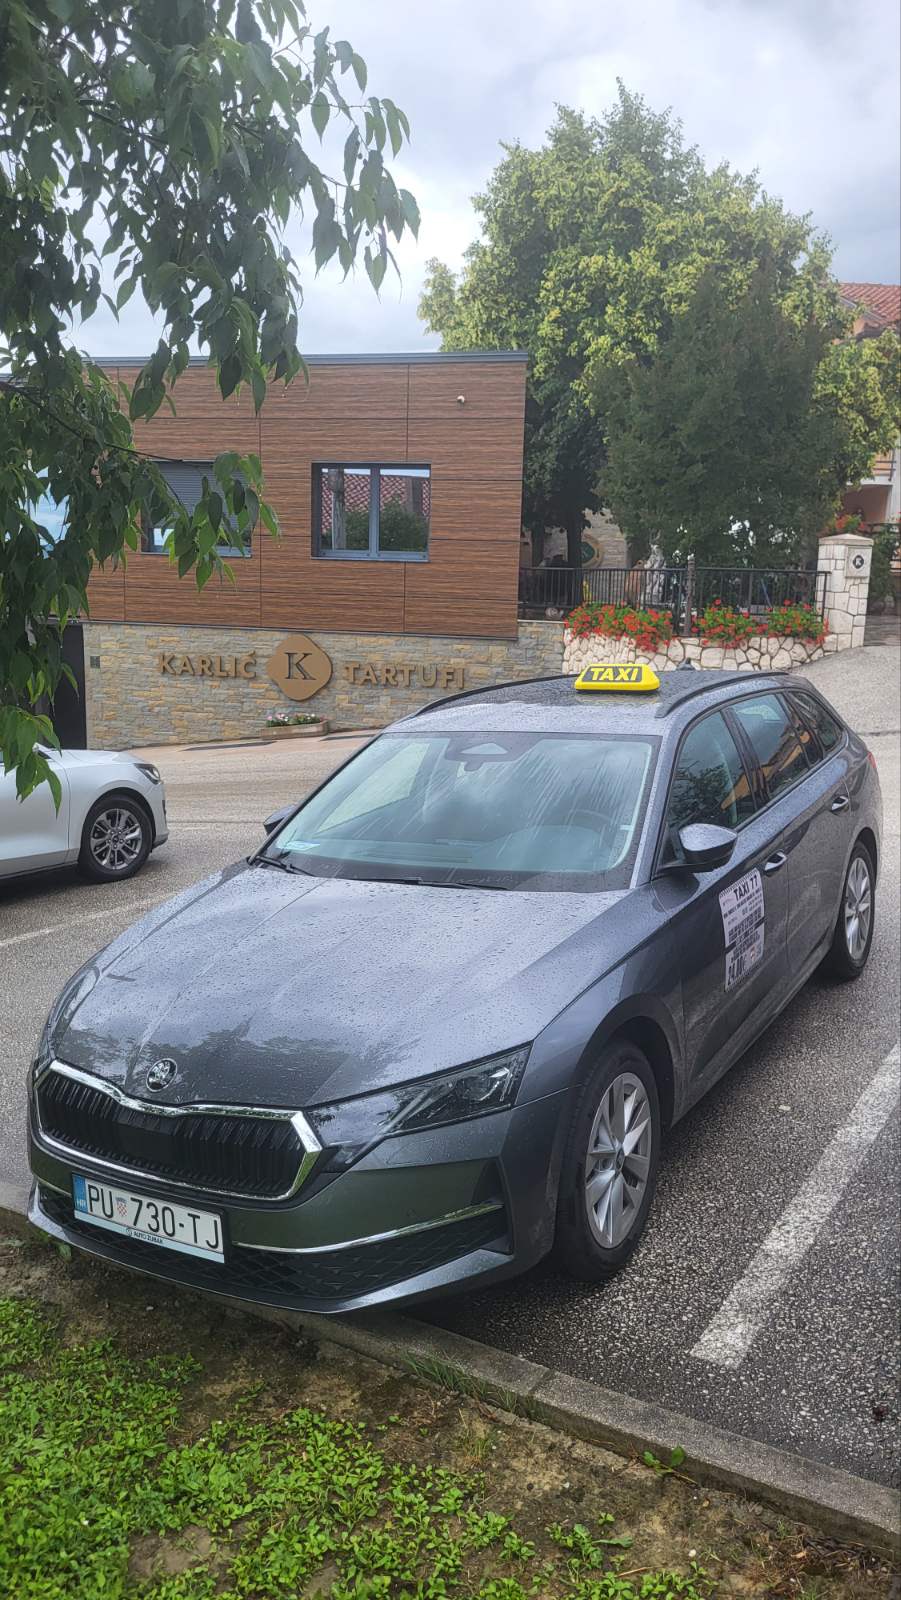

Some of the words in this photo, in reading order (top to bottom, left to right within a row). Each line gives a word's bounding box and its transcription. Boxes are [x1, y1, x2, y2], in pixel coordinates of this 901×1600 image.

[159, 651, 257, 679] KARLIĆ
[345, 662, 466, 689] TARTUFI
[284, 652, 316, 681] K
[590, 667, 639, 681] TAXI
[733, 882, 749, 901] TAXI
[750, 875, 758, 890] 77
[87, 1184, 114, 1219] PU
[130, 1197, 219, 1249] 730-TJ
[133, 1230, 147, 1240] AUTO
